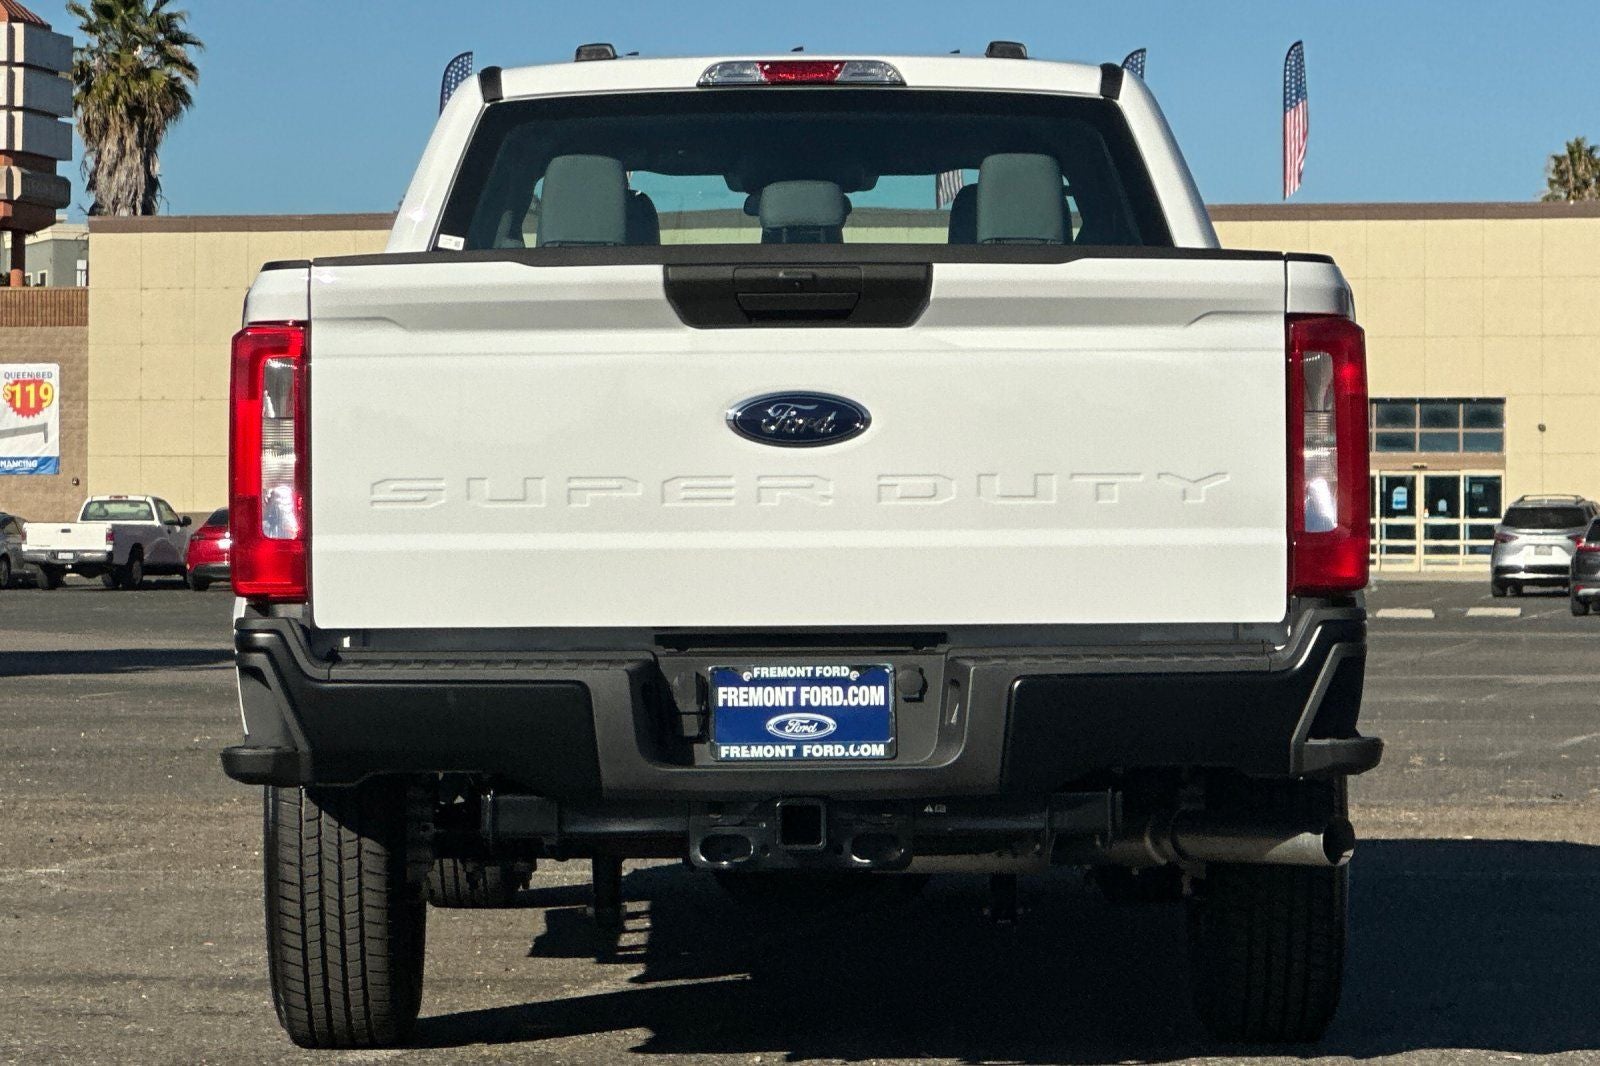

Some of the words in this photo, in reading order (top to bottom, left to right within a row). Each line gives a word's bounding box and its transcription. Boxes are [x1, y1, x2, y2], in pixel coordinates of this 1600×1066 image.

[4, 371, 33, 379] QUEEN
[35, 371, 53, 379] BED
[3, 381, 54, 408] $119
[761, 402, 837, 433] Ford
[370, 474, 835, 509] SUPER
[877, 471, 1231, 505] DUTY
[753, 666, 816, 678] FREMONT
[816, 666, 850, 677] FORD
[717, 686, 796, 707] FREMONT
[800, 685, 885, 706] FORD.COM
[784, 718, 818, 733] Ford
[720, 745, 796, 758] FREMONT
[803, 743, 885, 756] FORD.COM
